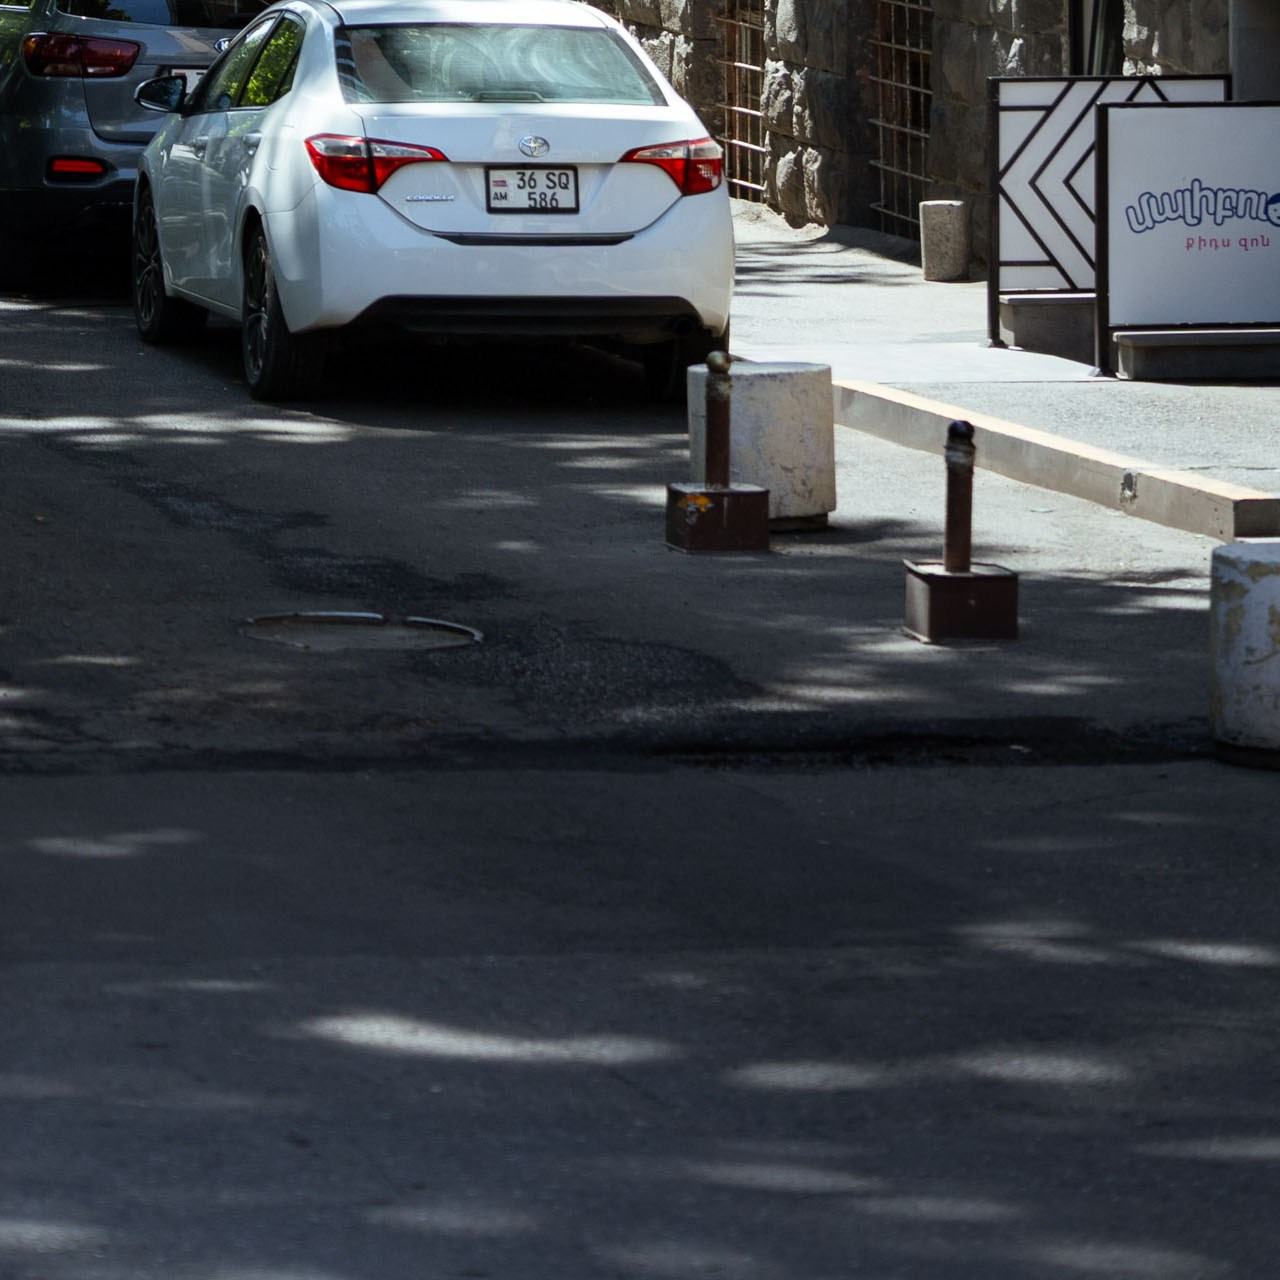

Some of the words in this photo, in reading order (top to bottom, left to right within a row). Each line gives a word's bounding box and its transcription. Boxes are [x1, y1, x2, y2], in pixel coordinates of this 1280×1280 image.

[516, 172, 537, 190] 36
[545, 172, 570, 190] SQ
[493, 192, 508, 201] AM
[528, 192, 559, 208] 586
